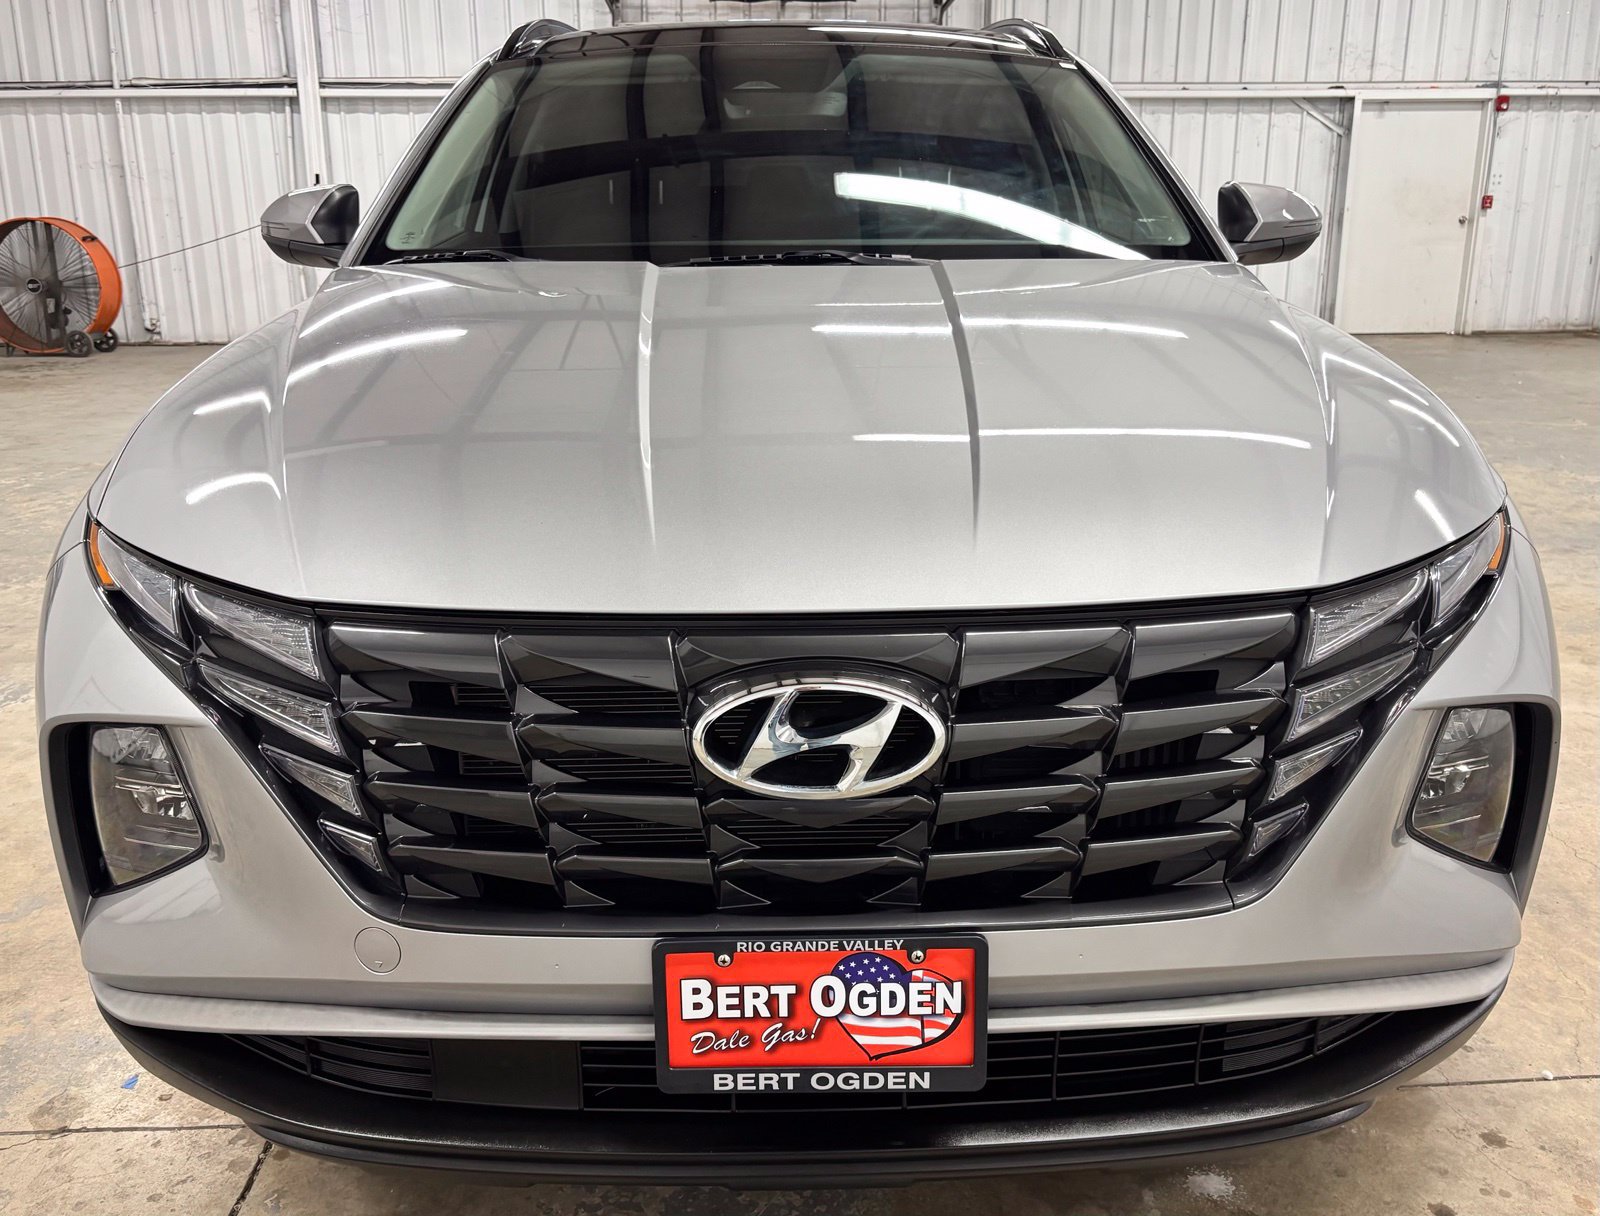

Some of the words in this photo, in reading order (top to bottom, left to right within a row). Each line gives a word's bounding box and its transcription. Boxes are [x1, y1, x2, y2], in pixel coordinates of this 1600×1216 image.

[736, 941, 766, 953] RIO
[770, 940, 840, 953] GRANDE
[842, 939, 904, 951] VALLEY
[679, 978, 797, 1021] BERT
[809, 974, 963, 1018] OGDEN
[690, 1029, 750, 1054] Dale
[761, 1017, 821, 1052] Gas!
[713, 1073, 800, 1091] BERT
[810, 1071, 930, 1090] OGDEN
